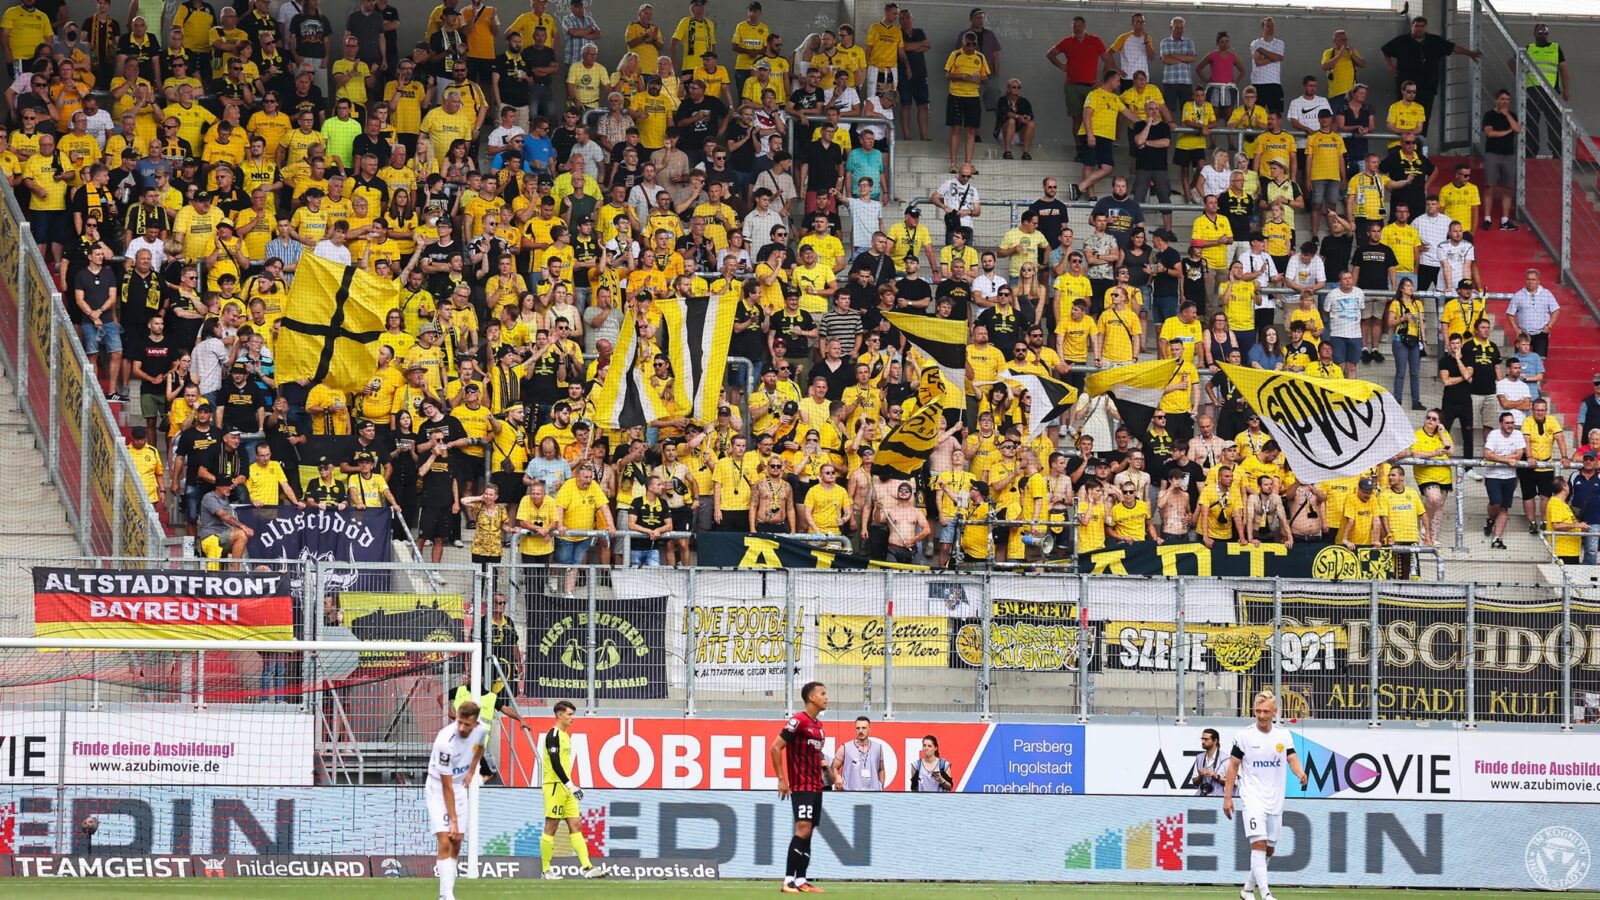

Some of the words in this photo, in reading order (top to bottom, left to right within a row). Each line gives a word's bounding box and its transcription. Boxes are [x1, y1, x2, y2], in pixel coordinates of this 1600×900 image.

[251, 172, 270, 180] NKD
[45, 573, 281, 596] ALTSTADTFRONT
[90, 601, 238, 622] BAYREUTH
[726, 606, 804, 634] FOOTBAL
[861, 620, 939, 641] Colettivo
[685, 635, 729, 664] ATE
[908, 640, 940, 657] Nero
[1265, 631, 1335, 672] 1921
[539, 676, 601, 698] OLDSCHDD
[606, 676, 648, 698] BARAID
[1490, 689, 1558, 716] KULT
[0, 736, 46, 776] IE
[73, 741, 109, 756] Finde
[112, 741, 150, 756] deine
[153, 742, 235, 758] Ausbildung!
[1013, 738, 1073, 756] Parsberg
[90, 760, 220, 773] www.azubimovie.de
[1009, 760, 1073, 776] Ingolstadt
[1475, 760, 1508, 775] Finde
[1511, 761, 1547, 775] deine
[983, 783, 1073, 794] moebelhof.de
[551, 805, 563, 816] 40
[798, 805, 813, 819] 22
[19, 797, 295, 856] EDIN
[1249, 818, 1257, 830] 6
[15, 857, 190, 877] TEAMGEIST
[236, 860, 365, 877] hildeGUARD
